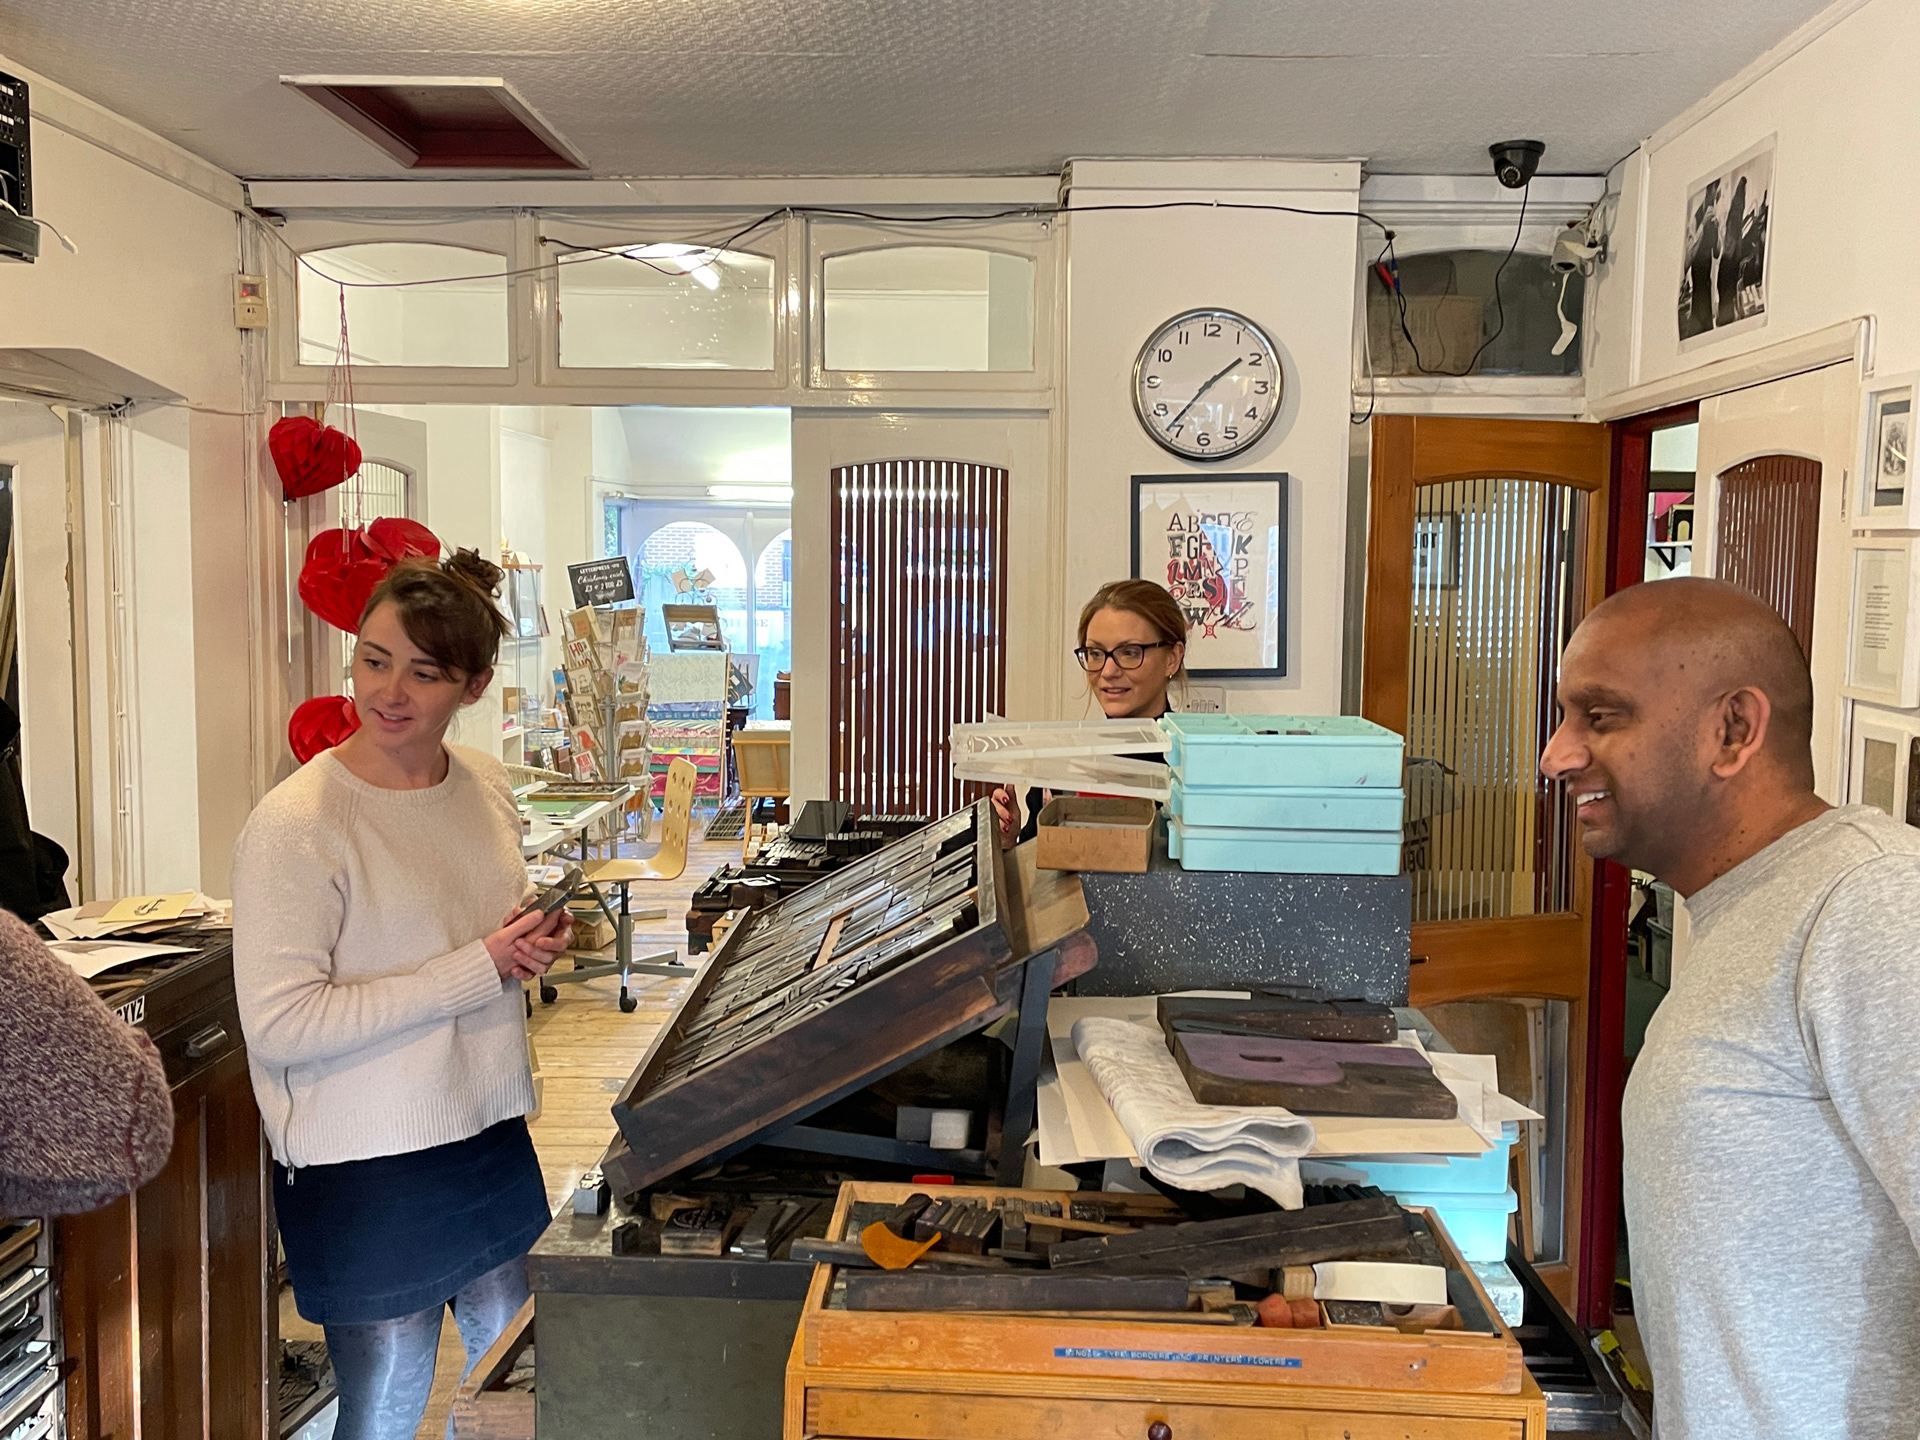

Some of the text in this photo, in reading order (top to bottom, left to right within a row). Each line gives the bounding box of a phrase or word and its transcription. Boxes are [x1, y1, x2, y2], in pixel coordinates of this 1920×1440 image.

[1204, 323, 1221, 337] 12
[1179, 331, 1188, 344] 11
[1237, 331, 1240, 344] 1
[1159, 349, 1172, 362] 10
[1249, 353, 1262, 366] 2
[1147, 376, 1161, 388] 9
[1255, 381, 1268, 394] 3
[1153, 404, 1168, 416] 8
[1245, 407, 1257, 420] 4
[1171, 424, 1184, 438] 7
[1224, 427, 1238, 439] 5
[1197, 433, 1210, 446] 6
